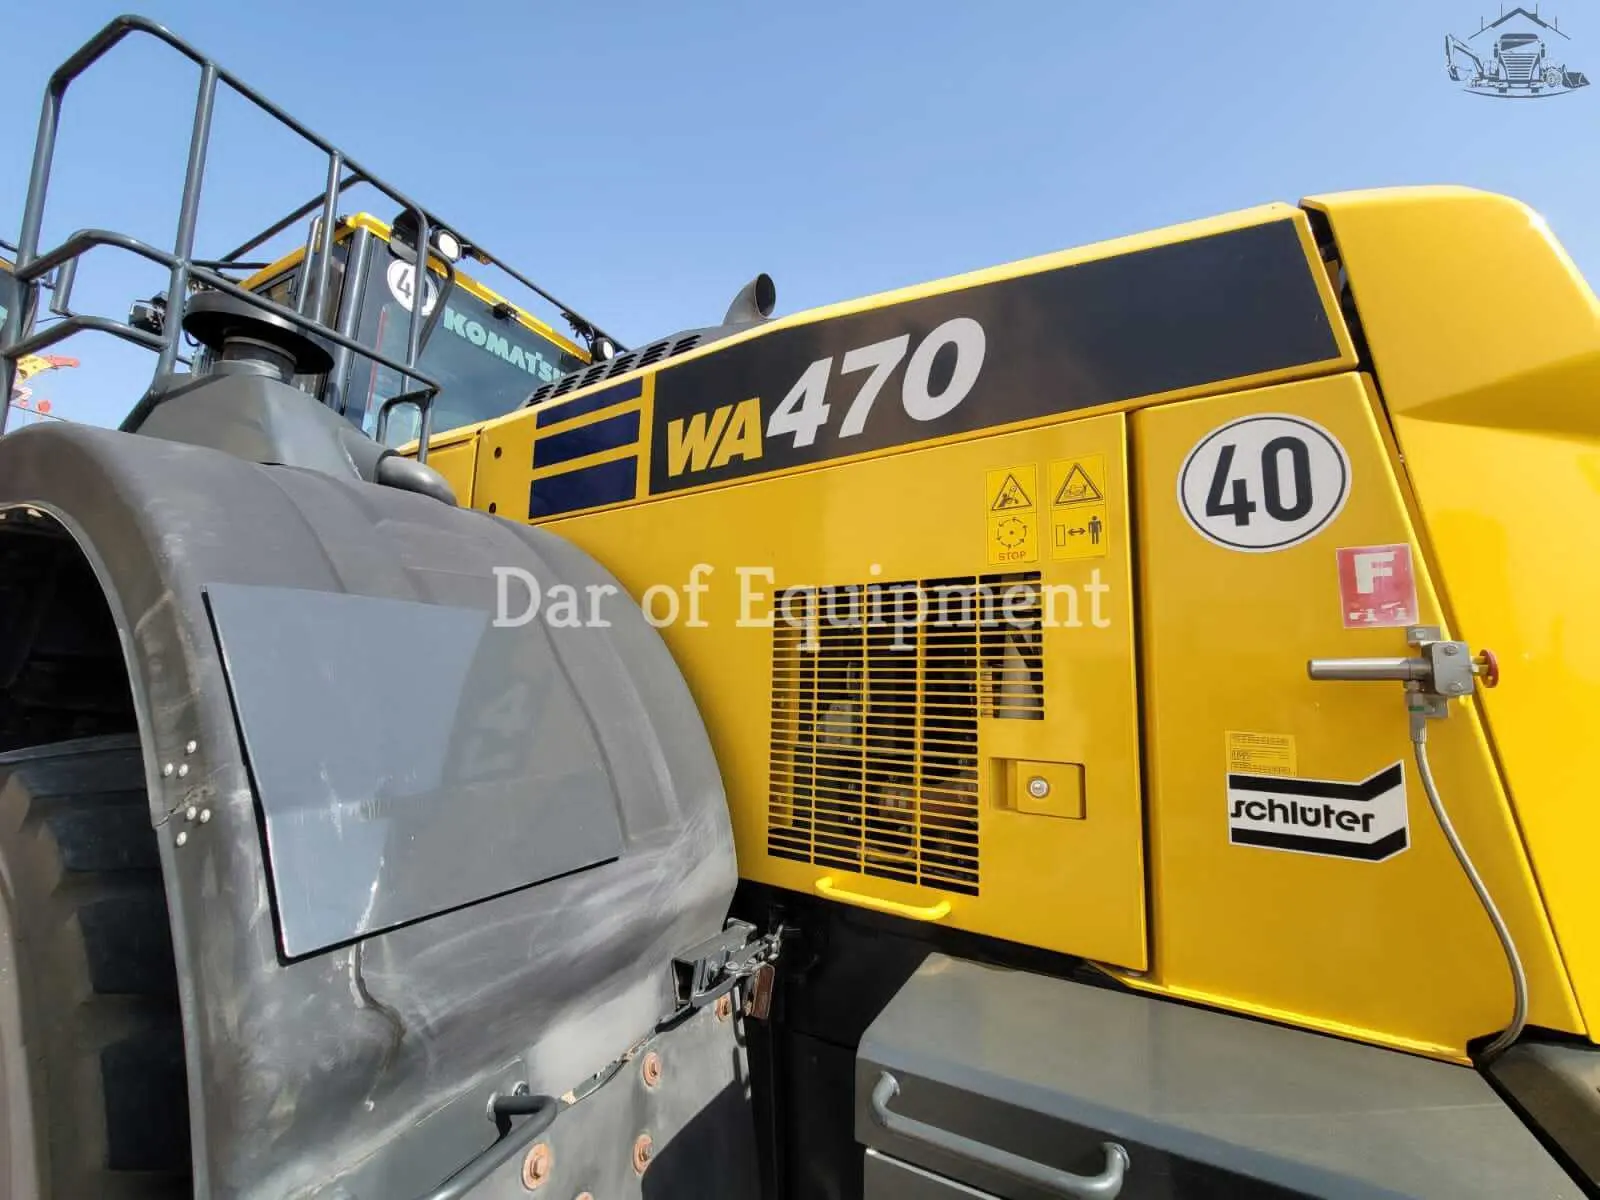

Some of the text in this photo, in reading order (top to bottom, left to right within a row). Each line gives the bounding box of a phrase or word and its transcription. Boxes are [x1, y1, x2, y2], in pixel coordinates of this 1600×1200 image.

[1206, 436, 1313, 526] 40
[998, 550, 1026, 561] STOP
[1353, 551, 1395, 594] F
